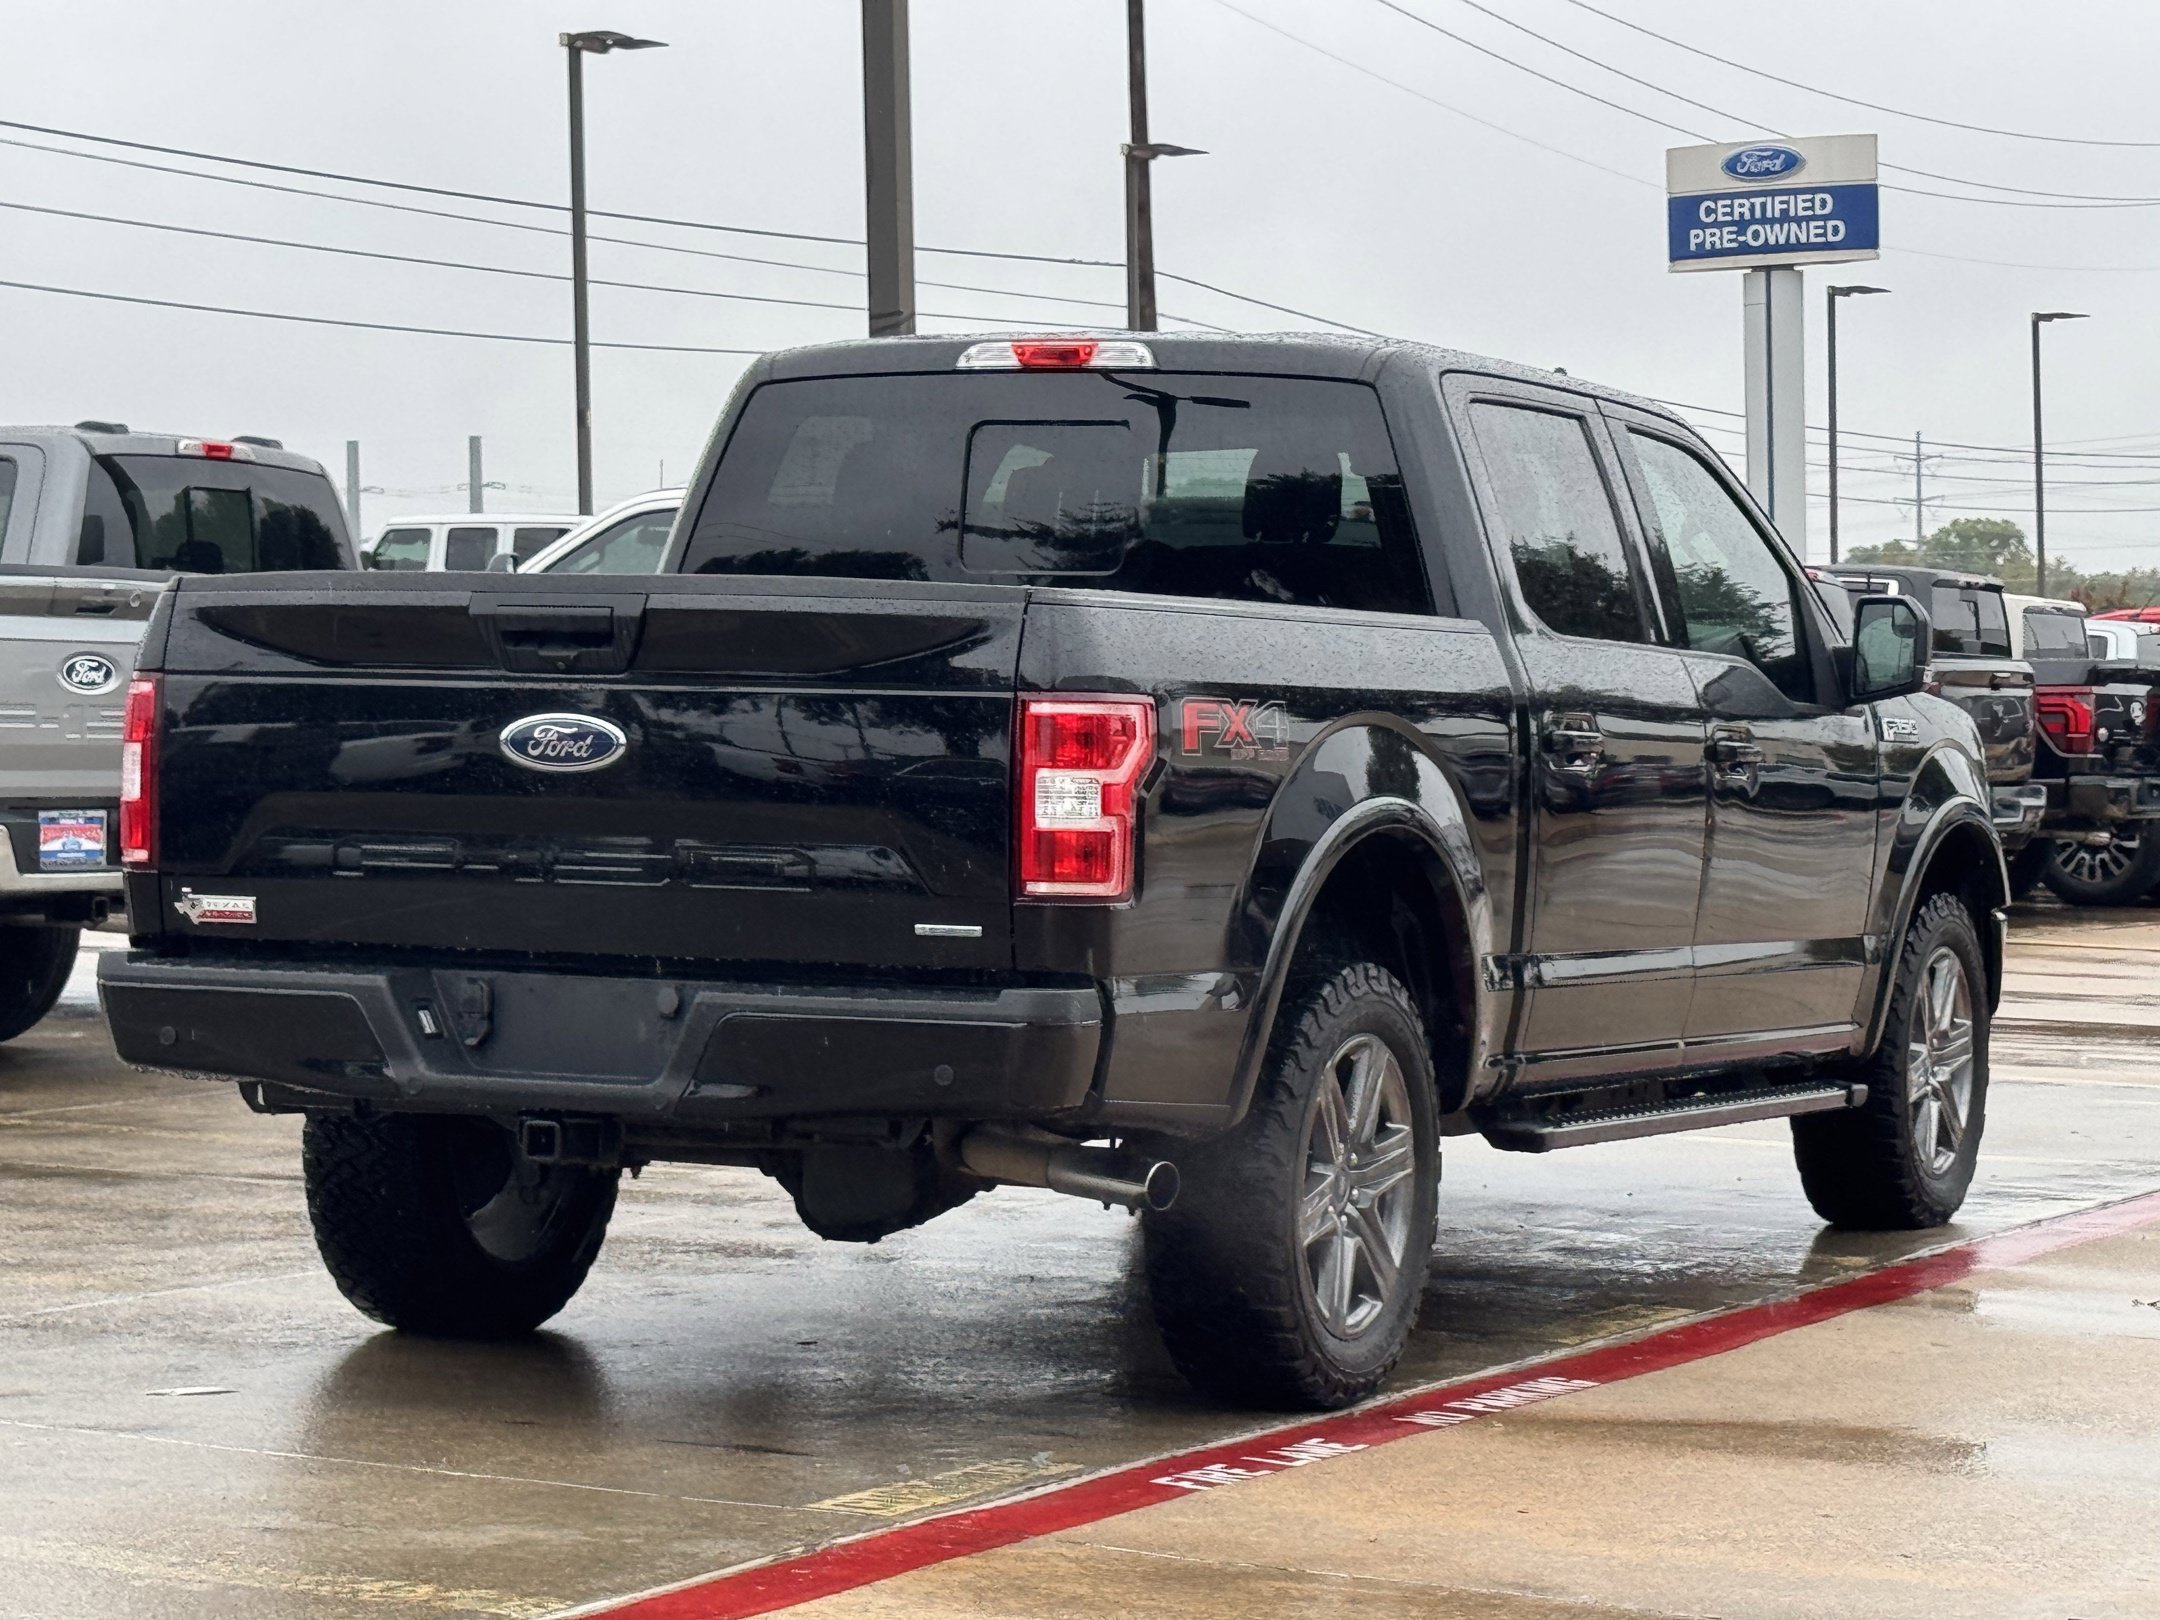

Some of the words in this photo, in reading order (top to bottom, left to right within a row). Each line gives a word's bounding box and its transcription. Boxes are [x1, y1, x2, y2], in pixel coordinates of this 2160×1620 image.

[1736, 150, 1786, 174] Ford
[1699, 192, 1834, 223] CERTIFIED
[1689, 219, 1847, 251] PRE-OWNED
[71, 659, 107, 684] Ford
[527, 724, 594, 758] Ford
[1181, 697, 1289, 757] FX4
[1148, 1463, 1275, 1491] FIRE
[1239, 1437, 1371, 1467] LANE
[1391, 1410, 1475, 1427] NO
[1442, 1376, 1602, 1412] PARKING
